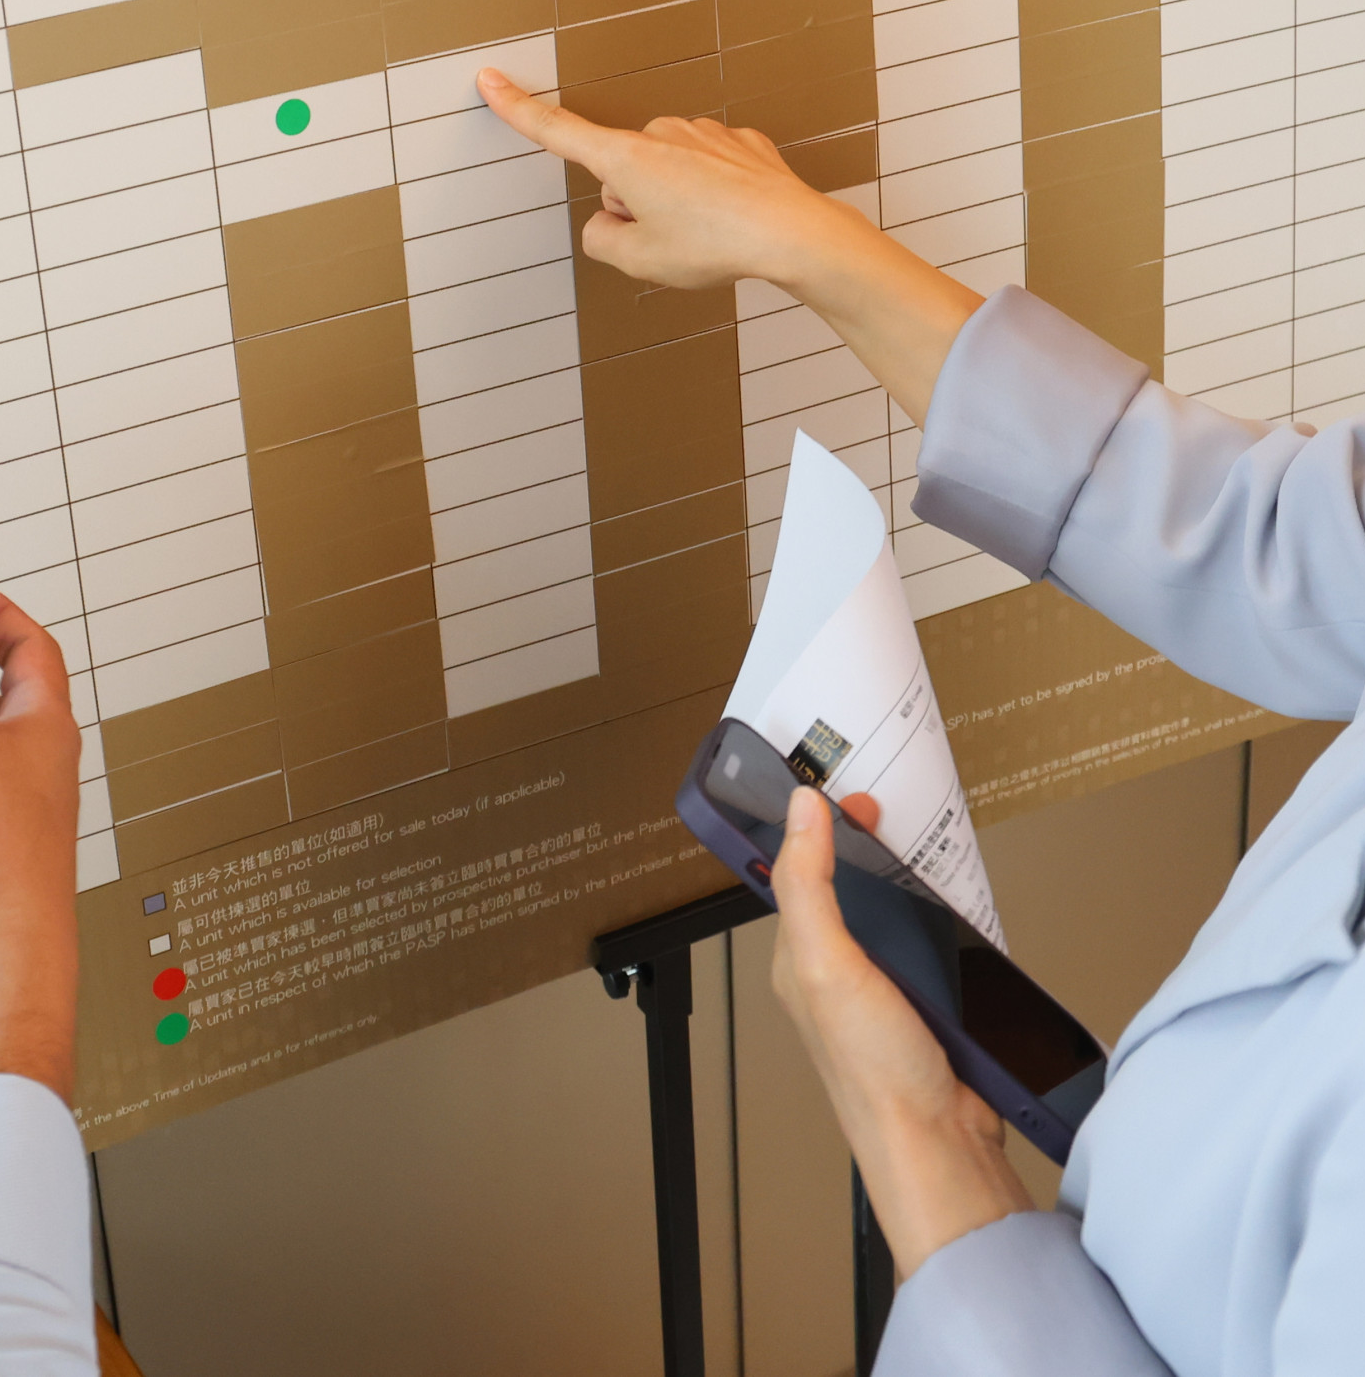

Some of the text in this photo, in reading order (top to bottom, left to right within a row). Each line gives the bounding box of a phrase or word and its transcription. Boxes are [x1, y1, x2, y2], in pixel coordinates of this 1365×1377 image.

[173, 774, 566, 913] A unit which is not offered for sale today (if applicable)
[178, 855, 443, 954] A unit which is available for selection
[184, 978, 197, 994] A
[201, 967, 229, 988] unit
[233, 950, 277, 977] which
[280, 941, 307, 960] has
[310, 928, 346, 949] been
[349, 903, 408, 935] selected
[411, 899, 429, 914] by
[432, 871, 512, 909] prospective
[515, 847, 581, 881] purchaser
[586, 836, 609, 855] but
[613, 829, 635, 845] the
[189, 1018, 202, 1034] A
[206, 1007, 234, 1028] unit
[238, 1002, 251, 1016] in
[254, 980, 308, 1010] respect
[311, 972, 328, 989] of
[333, 955, 374, 981] which
[379, 946, 401, 964] the
[405, 927, 446, 954] PASP
[450, 919, 476, 937] has
[479, 907, 513, 927] been
[516, 890, 560, 915] signed
[563, 886, 580, 900] by
[584, 878, 606, 894] the
[609, 856, 674, 888] purchaser
